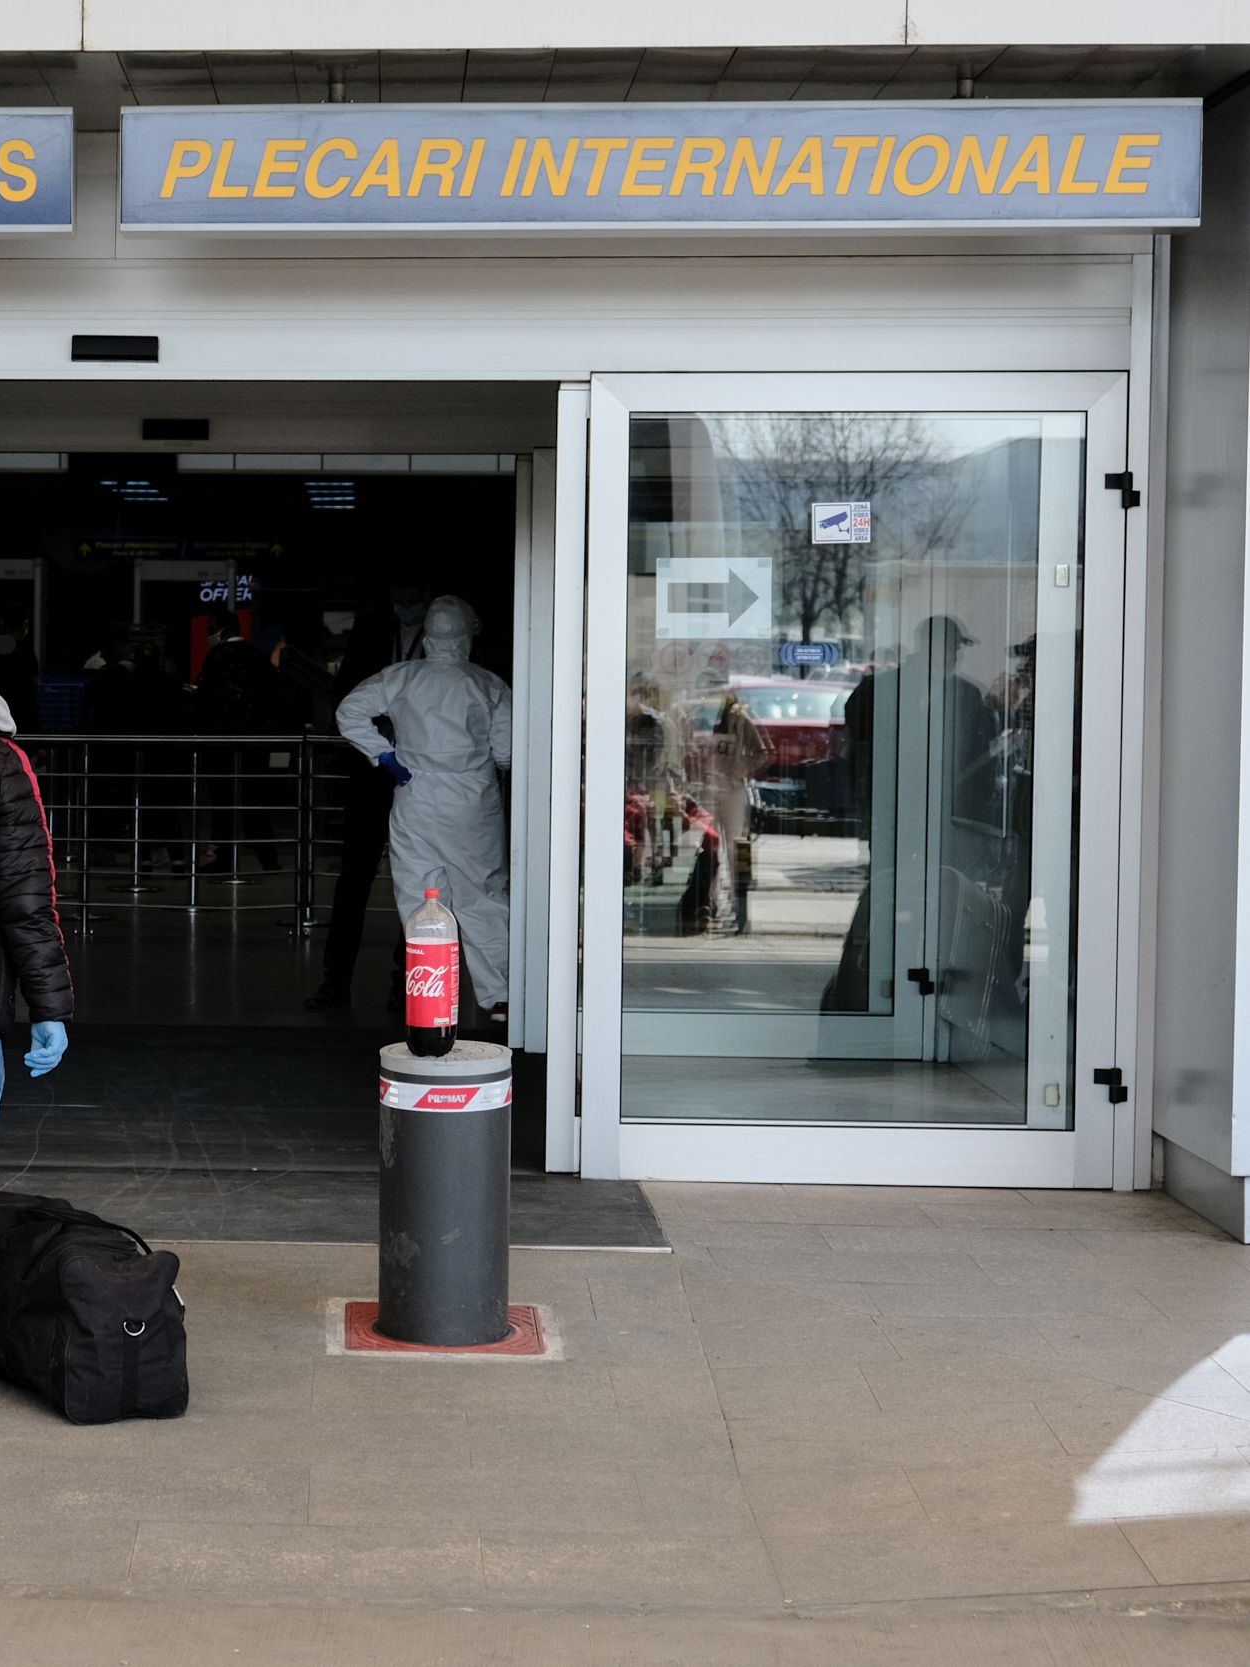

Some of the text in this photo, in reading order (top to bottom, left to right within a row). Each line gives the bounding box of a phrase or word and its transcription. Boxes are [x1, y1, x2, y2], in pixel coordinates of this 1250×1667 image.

[159, 133, 1161, 199] PLECARI INTERNATIONALE
[853, 518, 870, 528] 24H
